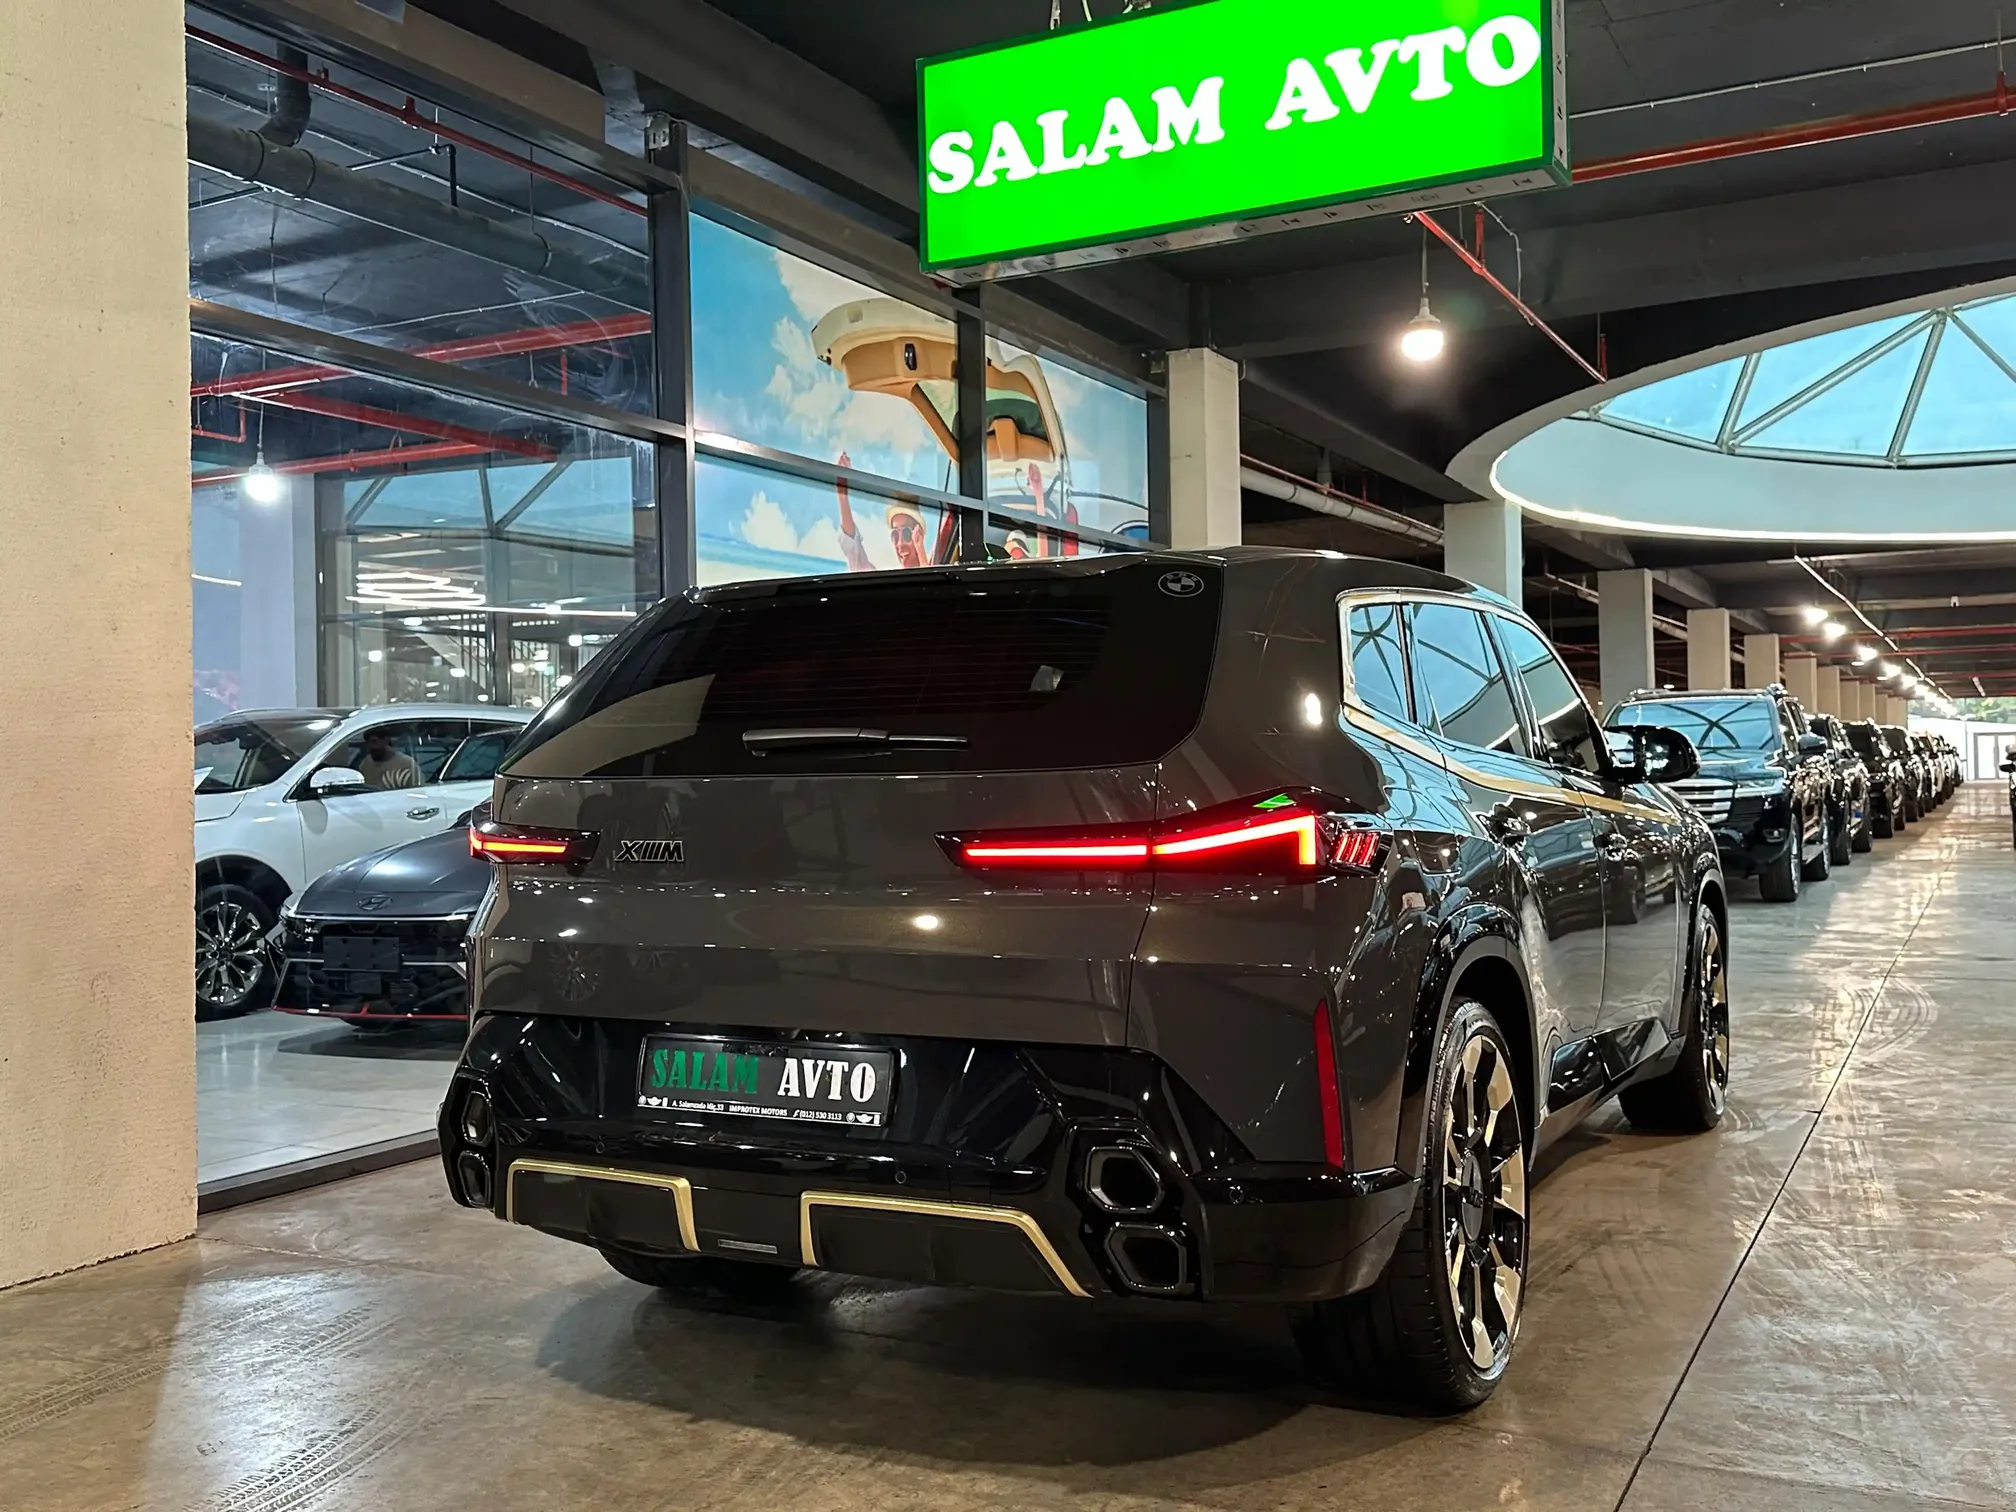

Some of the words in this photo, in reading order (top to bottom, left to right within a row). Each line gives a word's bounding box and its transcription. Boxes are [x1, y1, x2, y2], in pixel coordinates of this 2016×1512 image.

[928, 76, 1225, 194] SALAM
[1264, 15, 1541, 131] AVTO
[651, 1049, 759, 1094] SALAM
[777, 1058, 876, 1103] AVTO
[729, 1104, 760, 1114] IMPROTEX
[761, 1107, 788, 1117] MOTORS
[800, 1109, 815, 1120] (012)
[815, 1111, 827, 1120] 530
[827, 1112, 842, 1121] 3113
